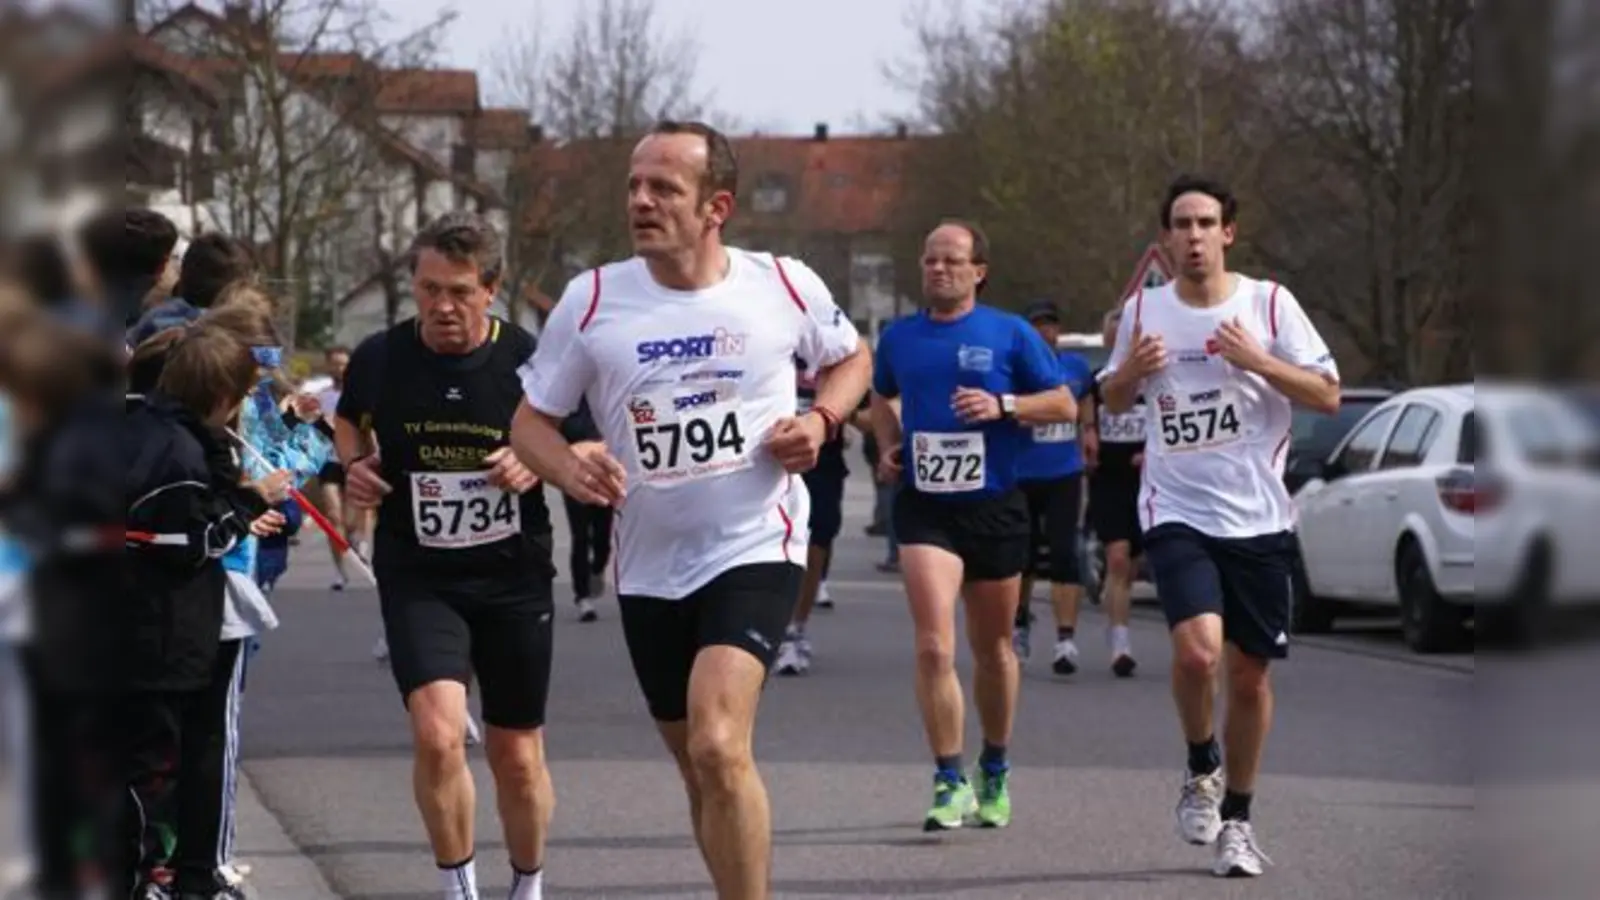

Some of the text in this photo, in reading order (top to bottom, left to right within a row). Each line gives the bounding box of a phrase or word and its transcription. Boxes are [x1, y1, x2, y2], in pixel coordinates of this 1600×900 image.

[635, 410, 745, 470] 5794
[1161, 403, 1241, 445] 5574
[917, 453, 981, 482] 6272
[419, 491, 515, 536] 5734
